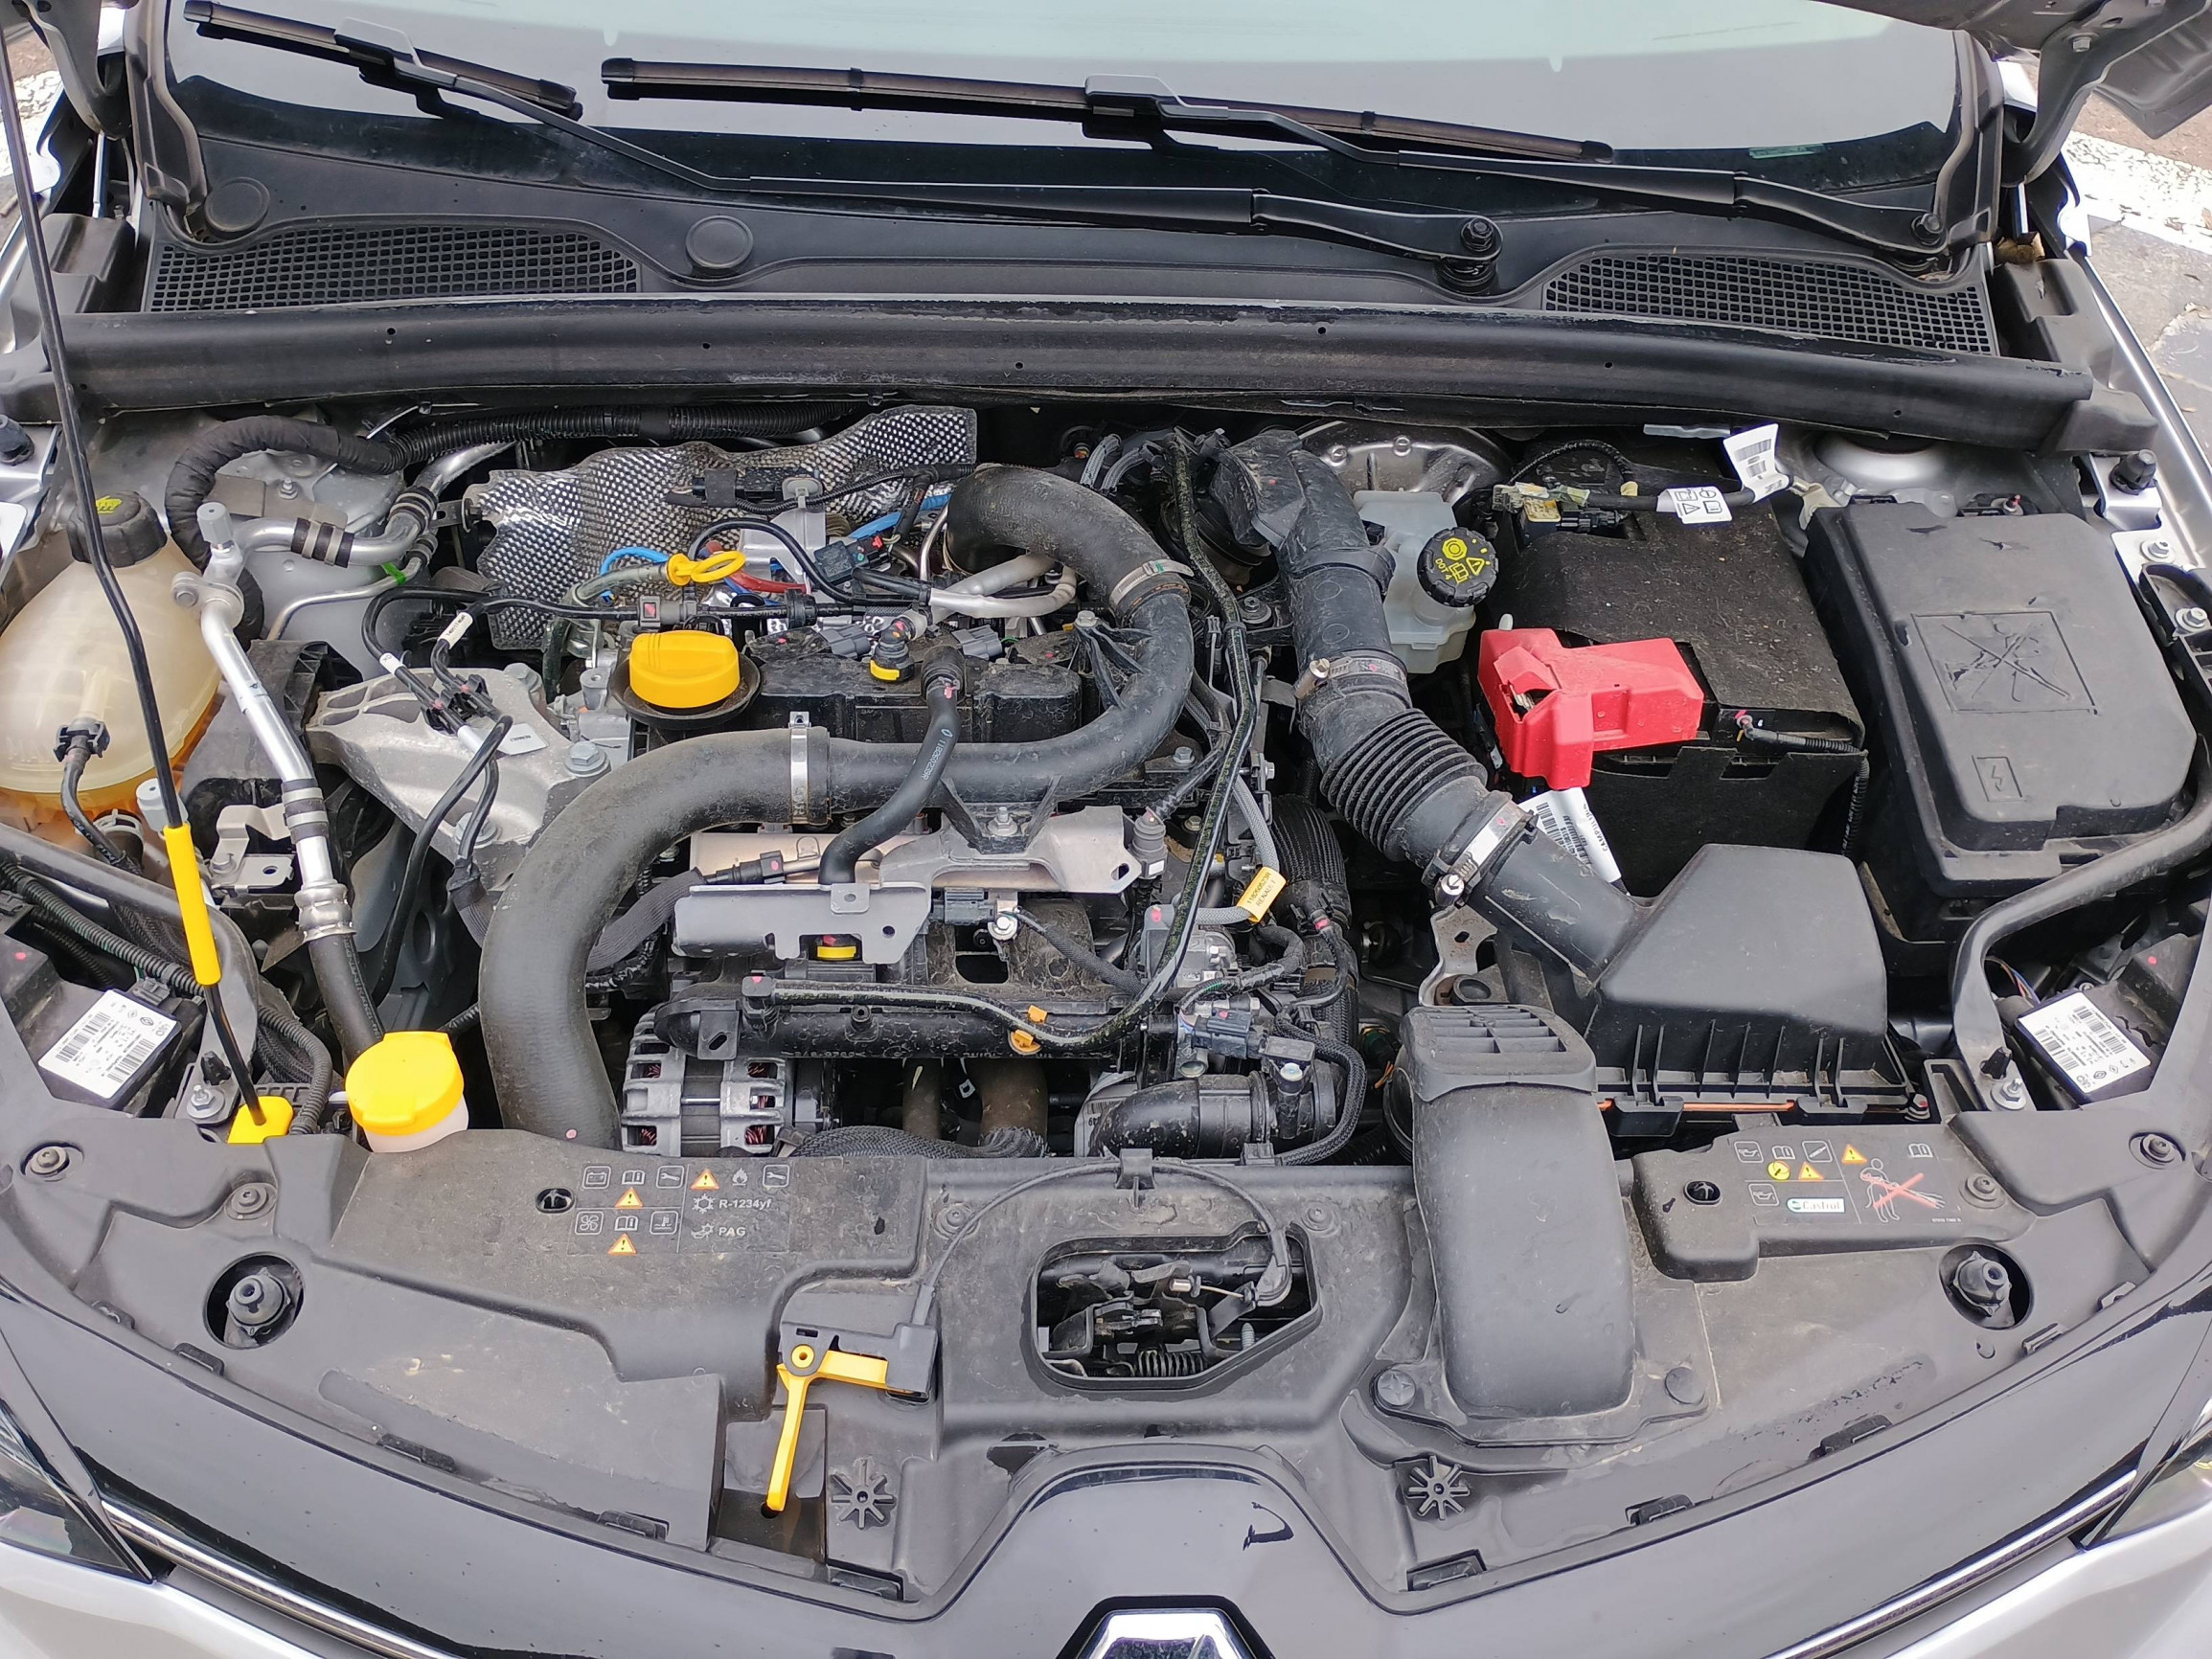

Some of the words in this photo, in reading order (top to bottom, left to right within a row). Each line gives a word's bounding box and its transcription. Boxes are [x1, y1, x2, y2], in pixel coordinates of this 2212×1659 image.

[1435, 558, 1448, 573] DOT
[718, 1198, 772, 1210] R-1234yf
[1802, 1199, 1841, 1211] Castrol
[718, 1226, 746, 1237] PAG
